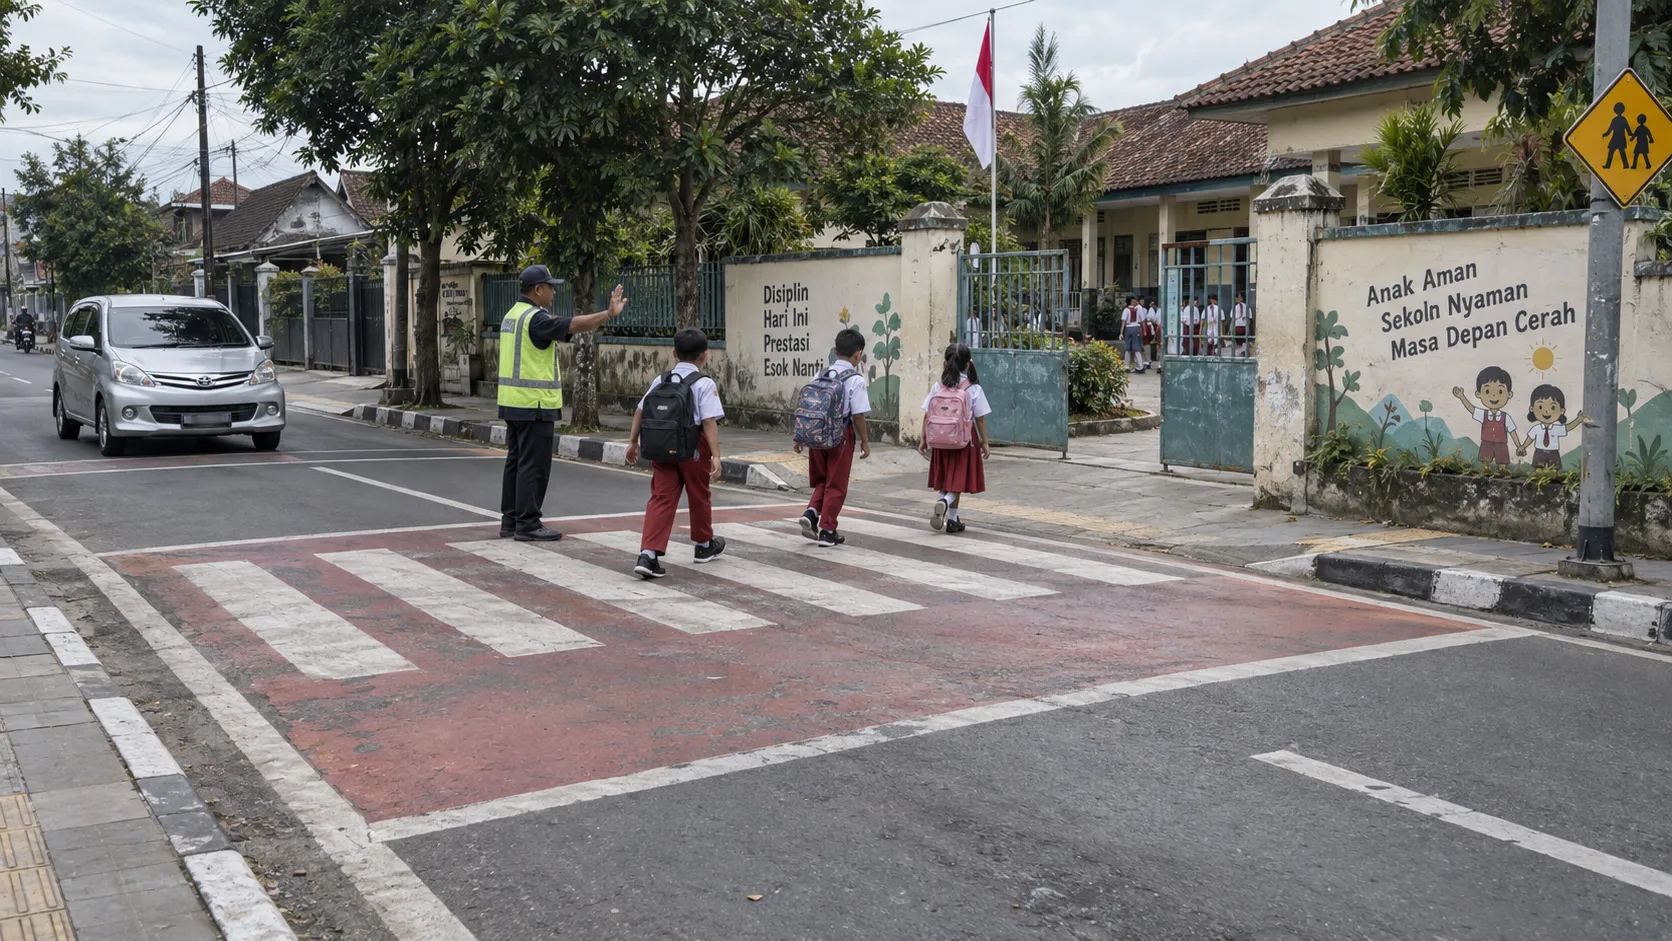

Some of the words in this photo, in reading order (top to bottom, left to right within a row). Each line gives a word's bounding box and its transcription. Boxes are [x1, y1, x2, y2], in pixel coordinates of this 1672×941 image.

[763, 282, 809, 308] Disiplin
[1366, 275, 1415, 307] Anak
[1422, 262, 1477, 291] Aman
[763, 309, 788, 329] Hari
[793, 307, 808, 327] Ini
[1381, 301, 1441, 333] Sekoln
[1448, 283, 1528, 318] Nyaman
[763, 332, 810, 353] Prestasi
[1391, 335, 1439, 361] Masa
[1446, 320, 1508, 349] Depan
[1515, 301, 1576, 333] Cerah
[763, 357, 789, 377] Esok
